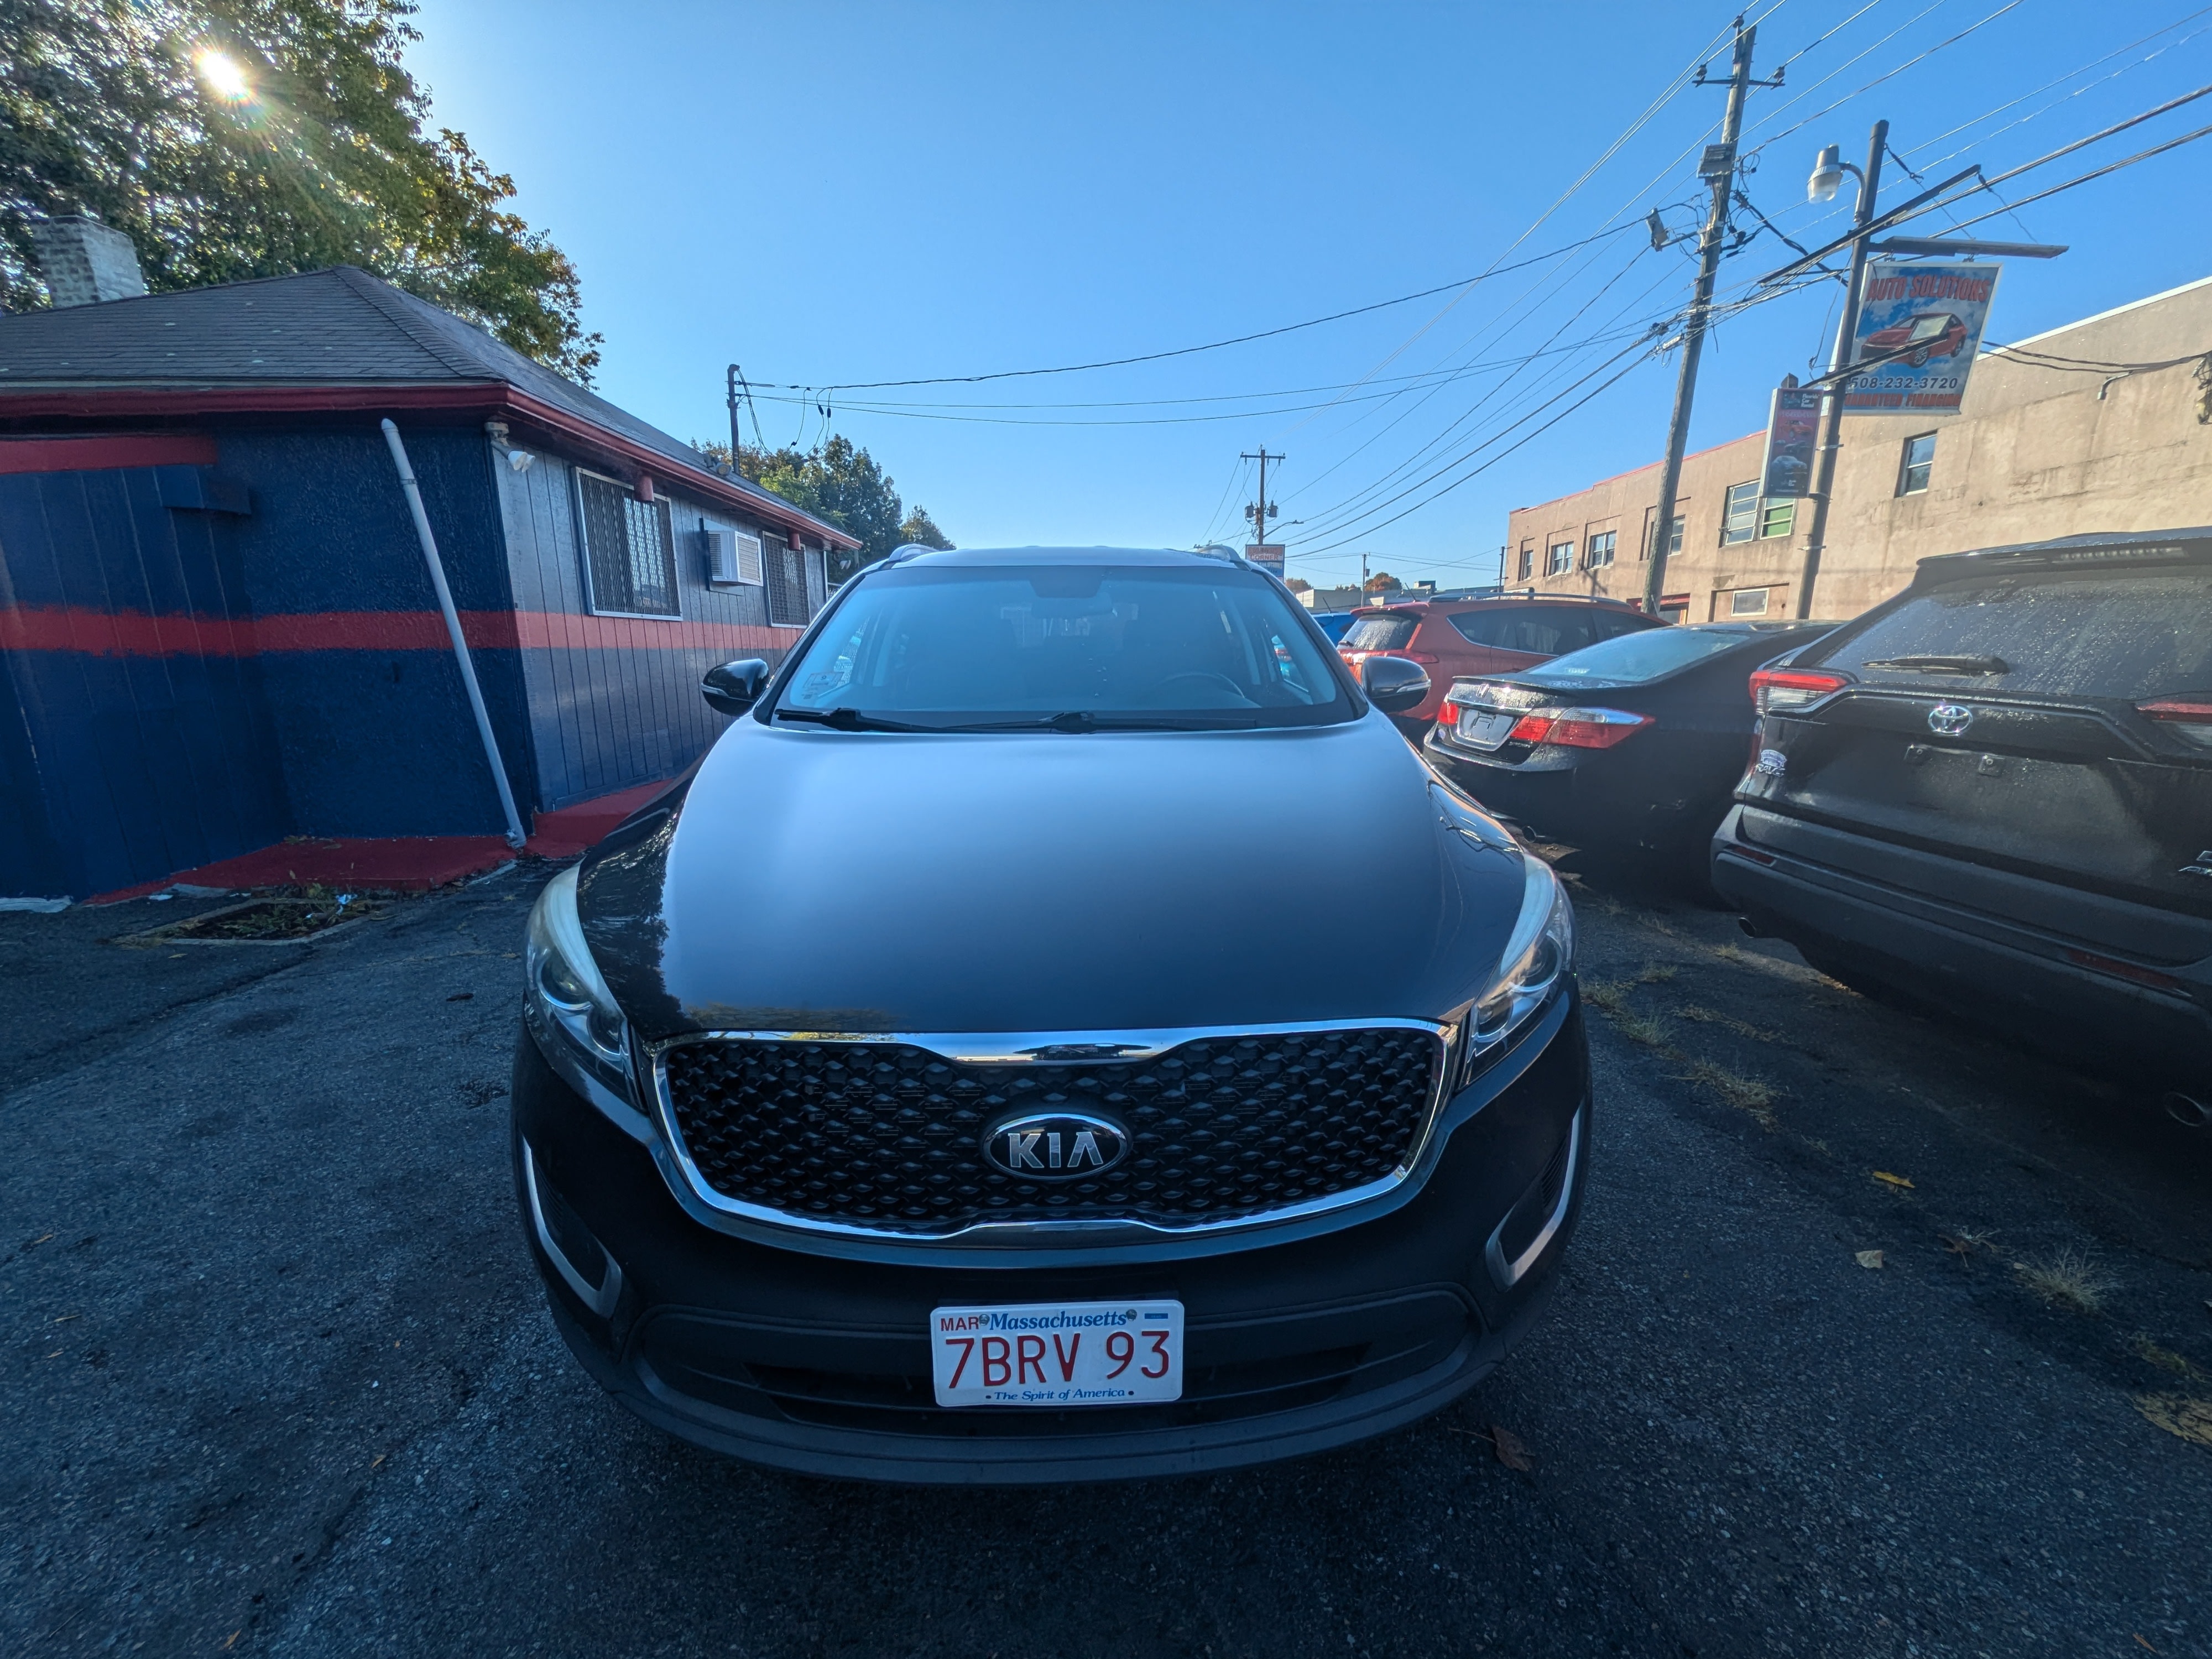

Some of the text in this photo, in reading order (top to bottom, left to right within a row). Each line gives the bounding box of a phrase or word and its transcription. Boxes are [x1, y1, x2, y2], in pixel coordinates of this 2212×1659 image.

[1866, 274, 1991, 302] AUTO SOLUTIONS
[1850, 377, 1959, 389] 508-232-3720
[1844, 393, 1962, 407] UARANTEED FINANCING
[1008, 1131, 1104, 1168] KIA
[941, 1311, 1127, 1331] MAR Massachusetts
[945, 1331, 1170, 1389] 7BRV 93
[994, 1388, 1125, 1402] The Spirit of America
